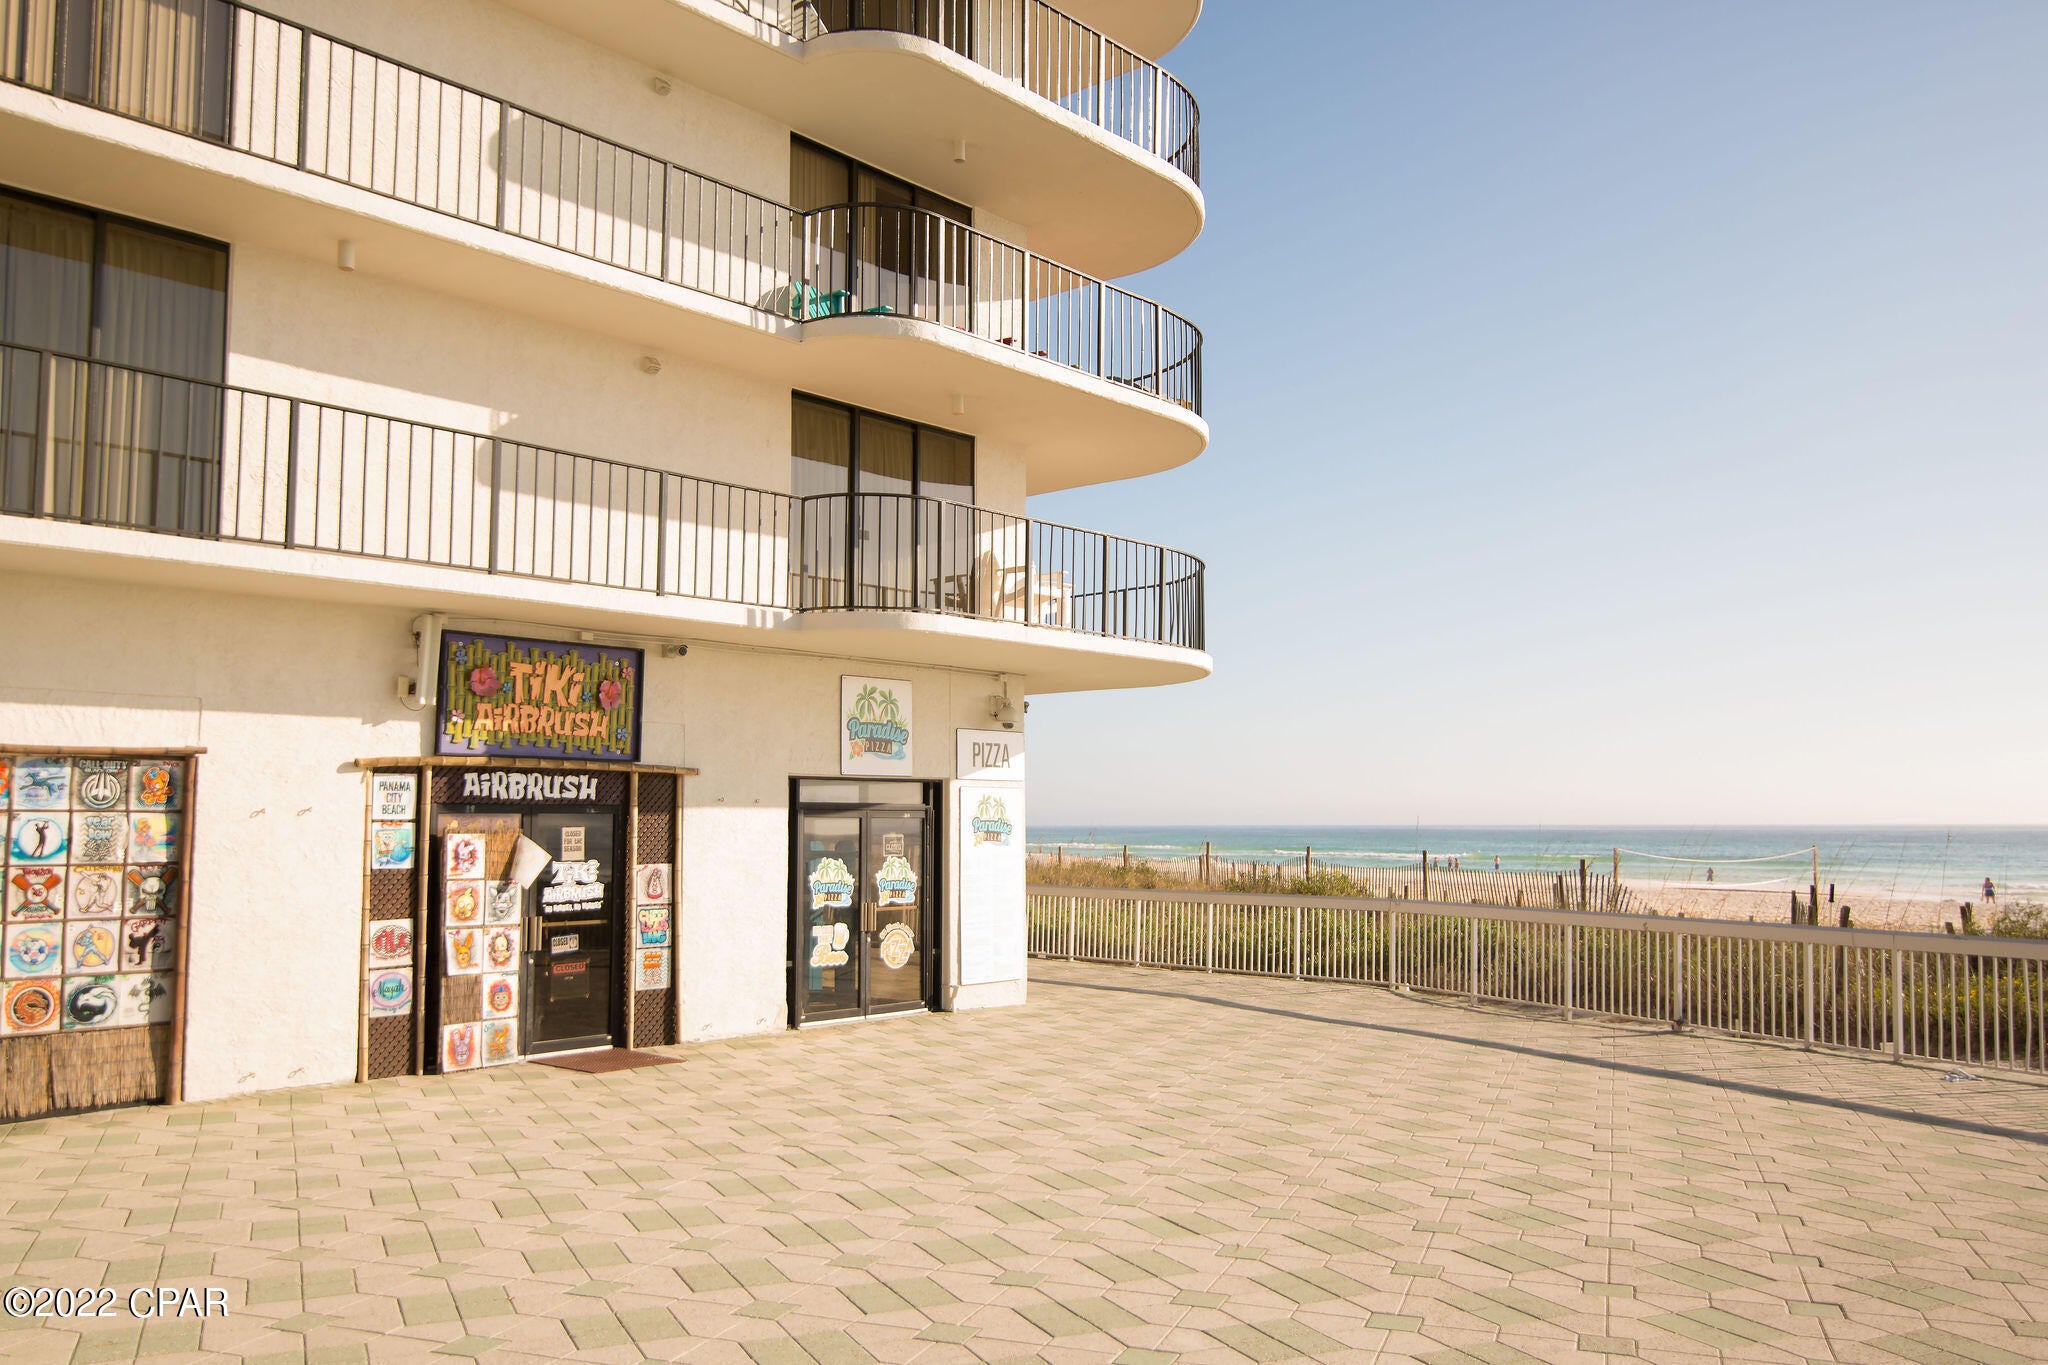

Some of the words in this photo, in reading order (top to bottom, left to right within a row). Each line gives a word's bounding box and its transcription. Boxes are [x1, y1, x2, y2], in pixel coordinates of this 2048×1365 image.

[847, 717, 909, 745] Paradise
[865, 741, 892, 753] PIZZA
[972, 742, 1010, 768] PIZZA
[379, 781, 411, 791] PANAMA
[386, 793, 403, 803] CITY
[382, 805, 406, 815] BEACH
[972, 817, 1012, 835] Paradise
[984, 832, 1002, 842] PIZZA
[813, 880, 852, 895] Paradise
[879, 878, 916, 892] Paradise
[824, 893, 842, 901] PIZZA
[889, 890, 906, 898] PIZZA
[552, 936, 569, 947] CLOSED
[556, 963, 584, 972] CLOSED
